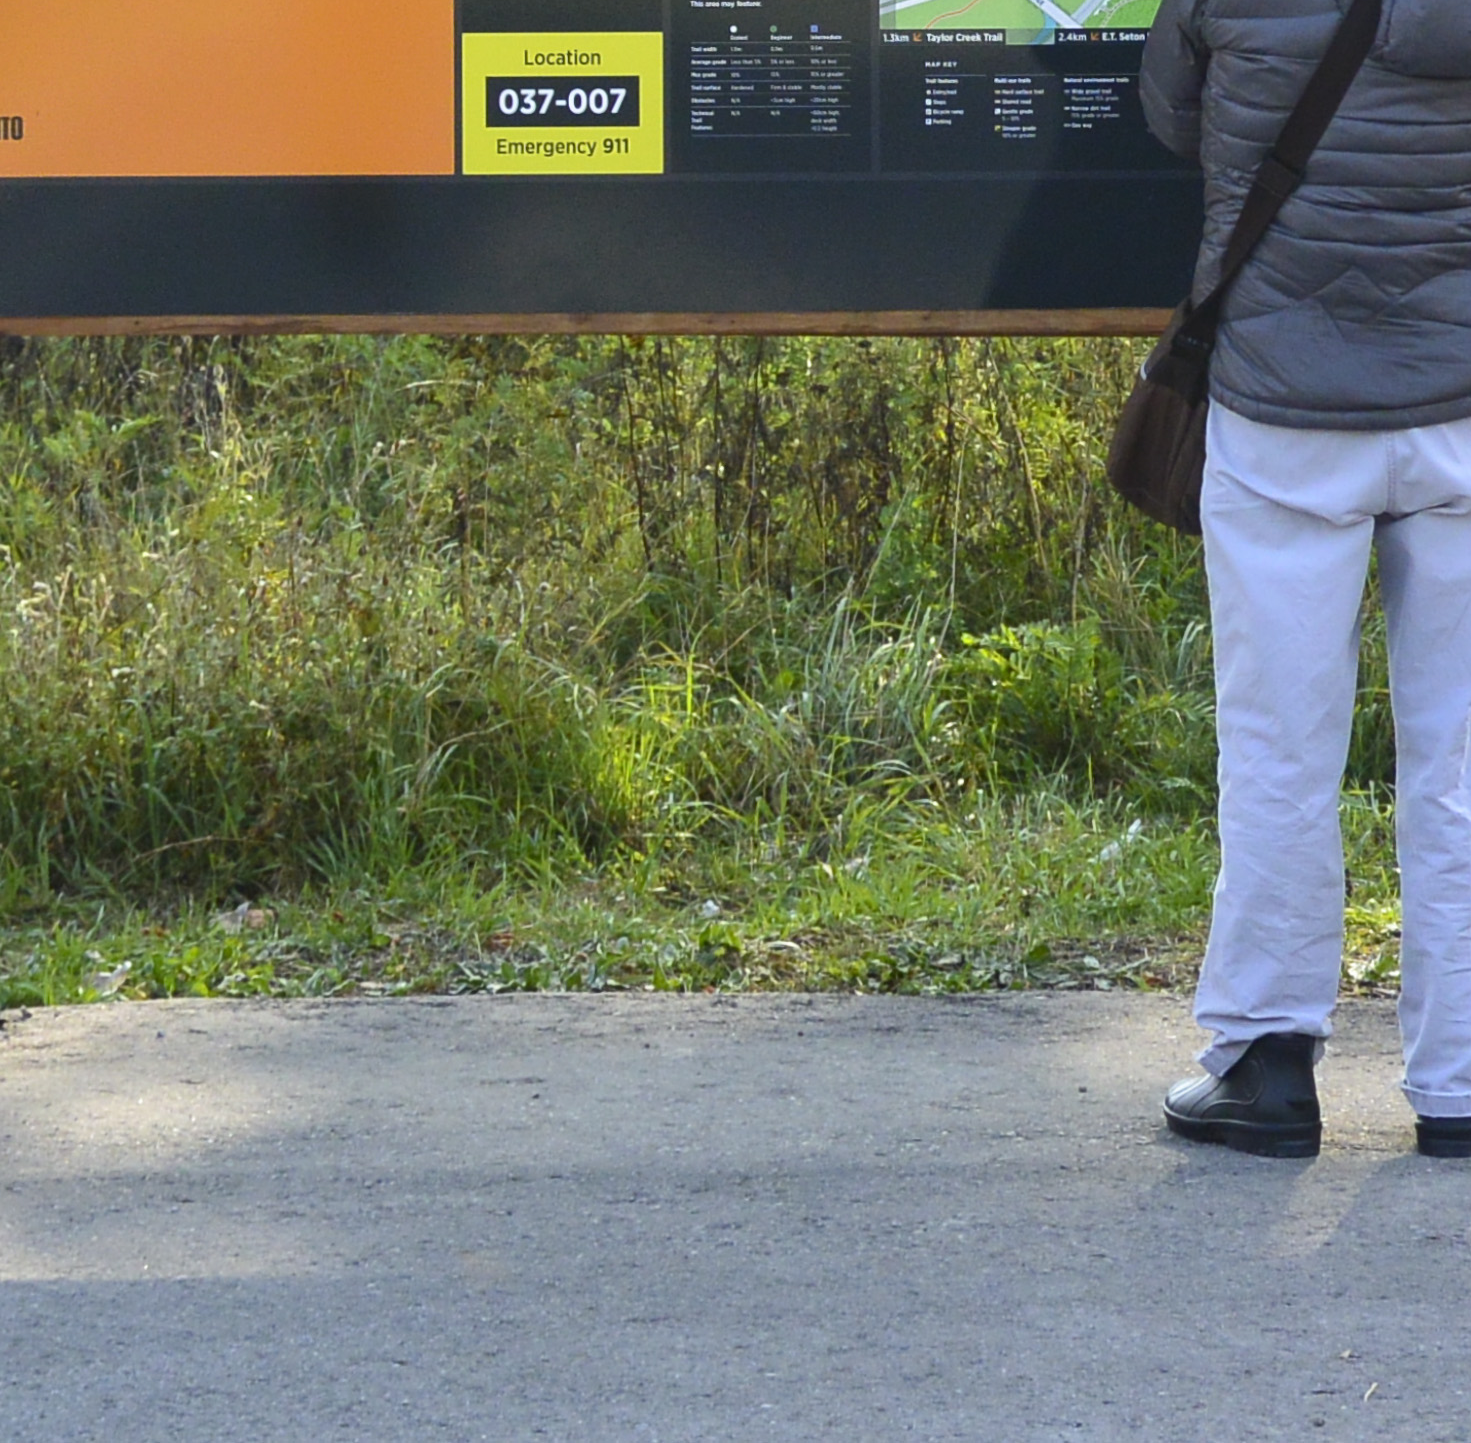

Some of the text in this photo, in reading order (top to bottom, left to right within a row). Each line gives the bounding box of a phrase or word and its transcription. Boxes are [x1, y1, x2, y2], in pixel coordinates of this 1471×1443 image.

[883, 33, 1003, 43] 1.3km Taylor Creek Trail
[1058, 32, 1145, 42] 2.4km E.T. Seton
[524, 50, 602, 65] Location
[498, 88, 627, 115] 037-007
[496, 138, 629, 157] Emergency 911
